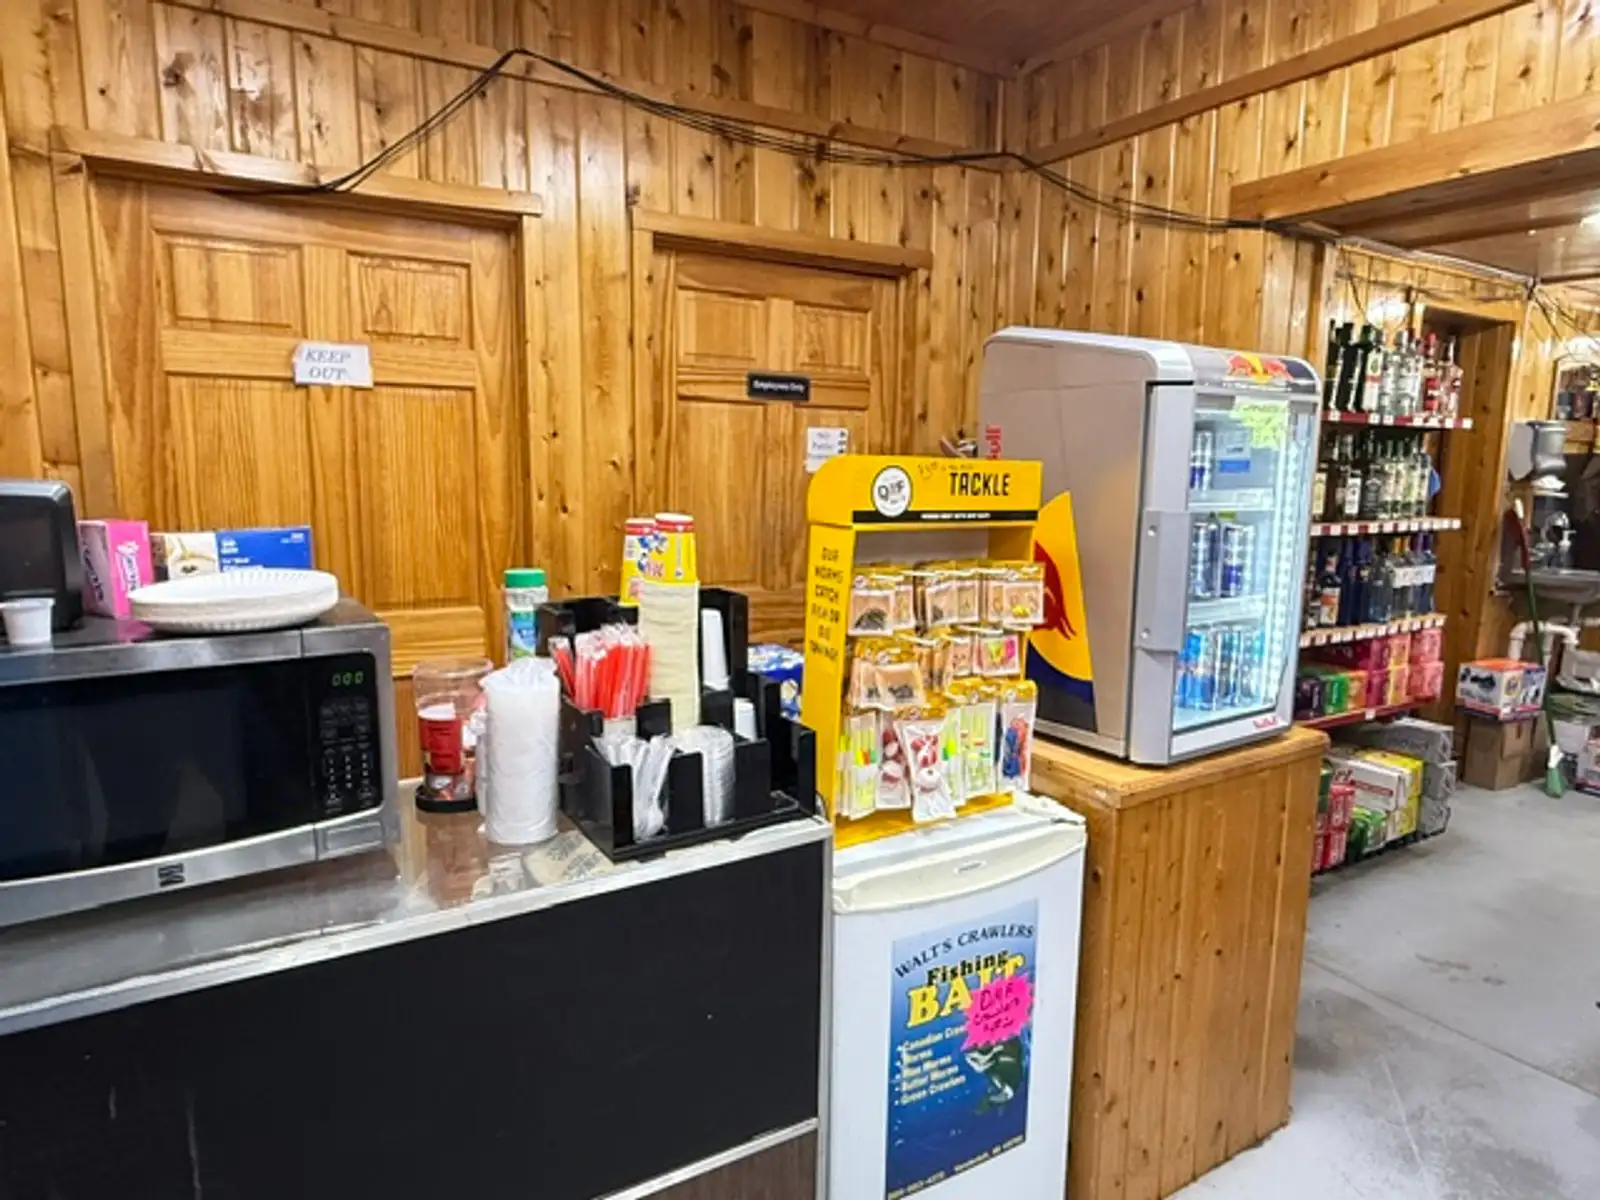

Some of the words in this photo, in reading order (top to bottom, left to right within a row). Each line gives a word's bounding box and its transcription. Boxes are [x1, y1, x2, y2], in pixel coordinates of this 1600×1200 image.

[305, 348, 352, 364] KEEP
[308, 366, 348, 381] OUT
[950, 472, 1012, 497] TACKLE
[894, 937, 953, 978] WALT'S
[957, 923, 1034, 947] CRAWLERS
[926, 949, 1010, 987] Fishing
